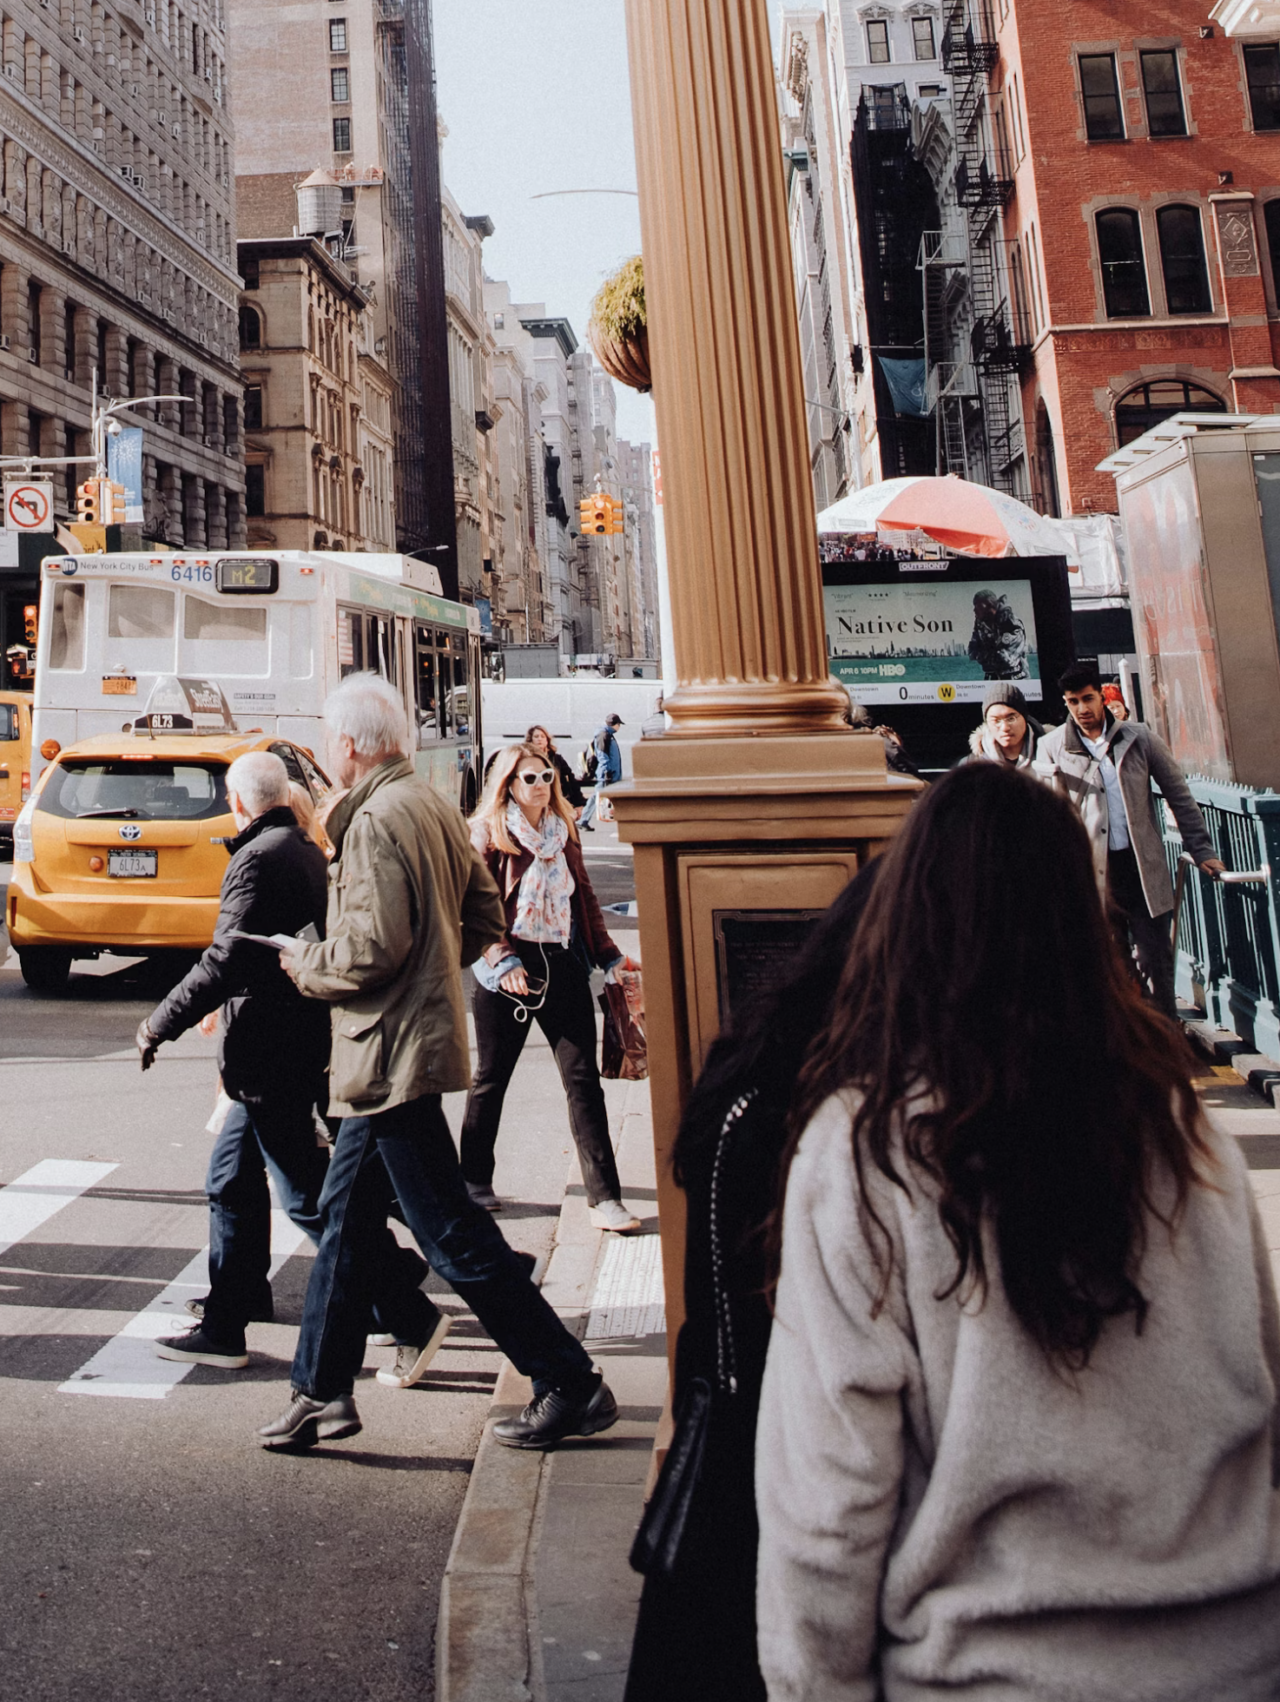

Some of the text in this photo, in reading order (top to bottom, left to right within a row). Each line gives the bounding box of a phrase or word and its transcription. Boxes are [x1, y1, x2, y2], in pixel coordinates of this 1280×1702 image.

[80, 562, 98, 570] New
[100, 562, 117, 570] York
[120, 562, 136, 571] City
[138, 563, 154, 571] Bus
[171, 565, 213, 582] 6416
[231, 565, 256, 585] M2
[836, 614, 954, 635] Native Son
[840, 667, 854, 675] APR
[879, 664, 906, 676] HBO
[940, 687, 952, 698] W
[152, 714, 174, 728] 6L73
